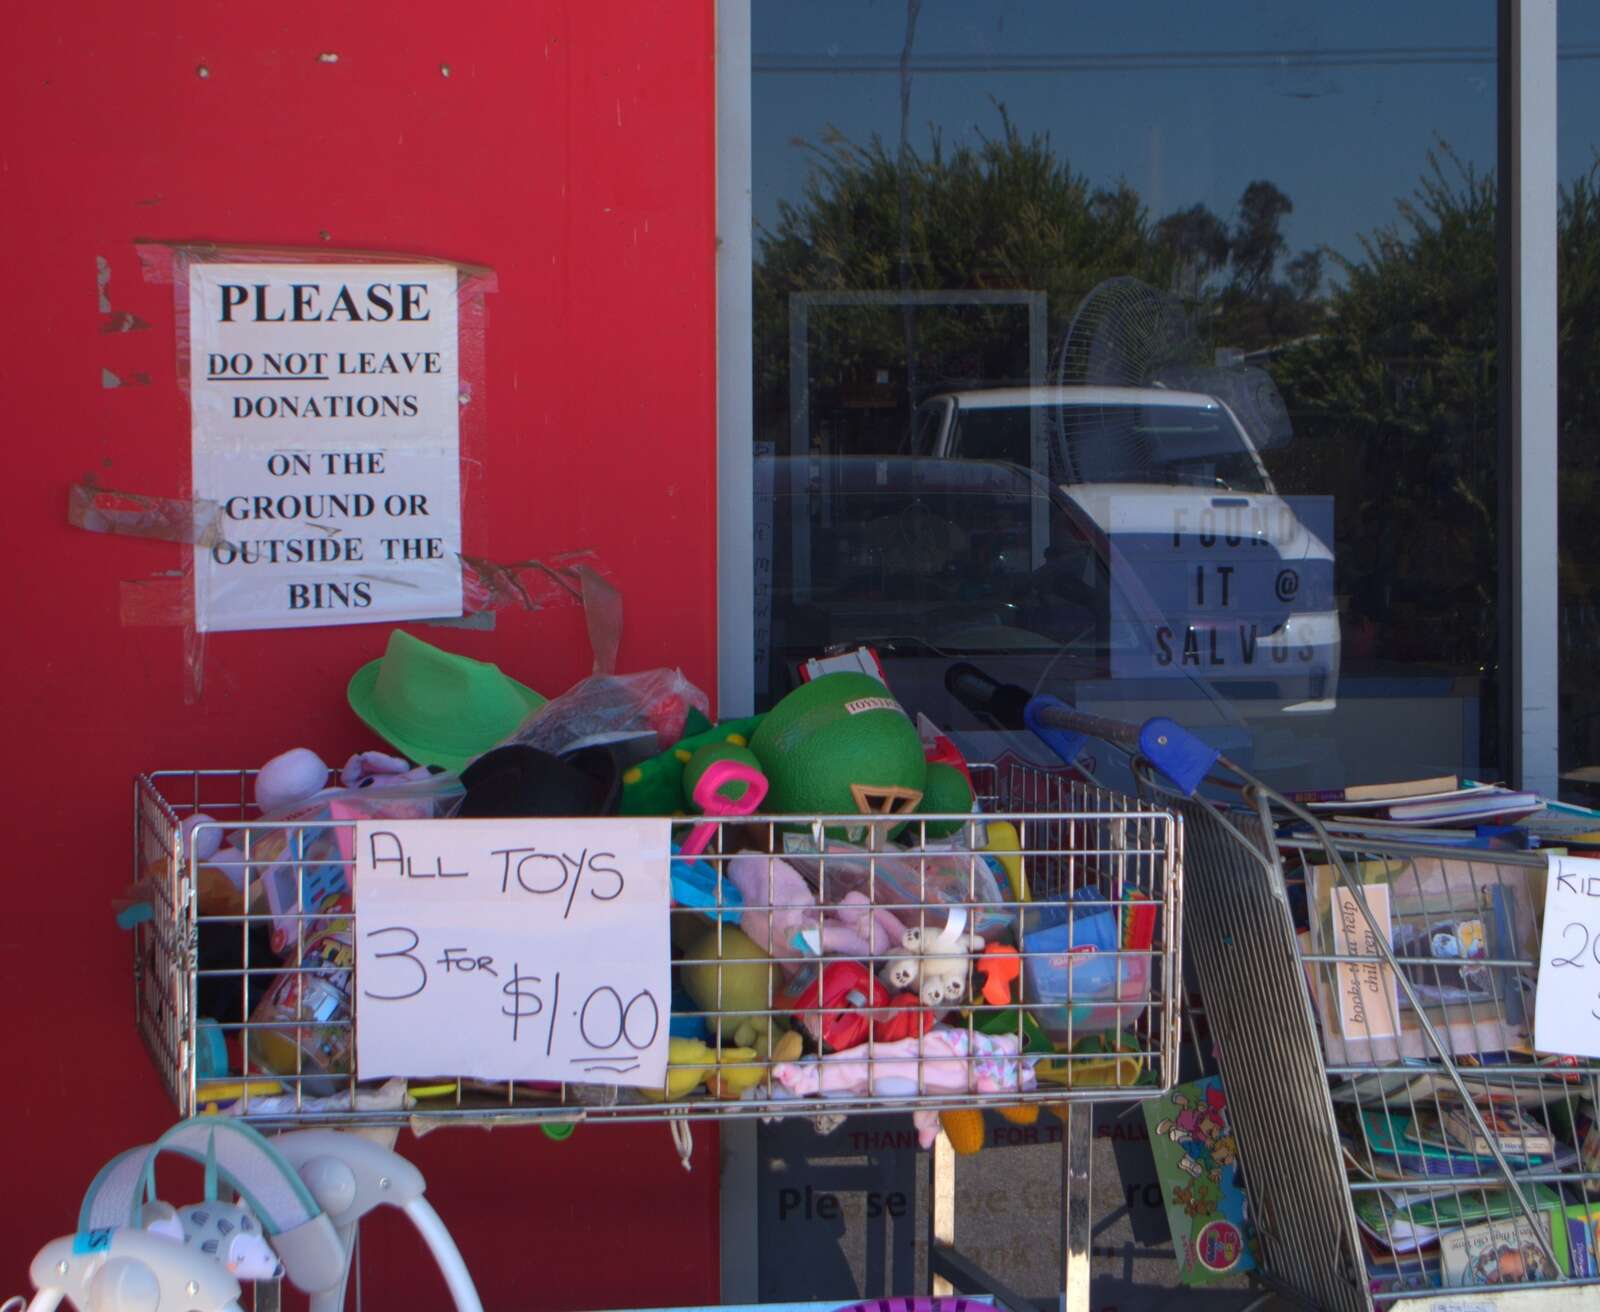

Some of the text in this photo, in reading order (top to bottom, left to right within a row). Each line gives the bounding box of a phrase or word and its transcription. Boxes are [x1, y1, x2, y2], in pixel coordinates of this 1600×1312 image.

[217, 283, 431, 323] PLEASE
[207, 351, 442, 377] DO NOT LEAVE
[232, 395, 419, 420] DONATIONS
[267, 452, 385, 477] ON THE
[225, 493, 430, 521] GROUND OR
[1173, 507, 1299, 548] FOUND
[211, 537, 445, 566] OUTSIDE THE
[288, 581, 373, 611] BINS
[1196, 565, 1299, 606] IT @
[1156, 624, 1314, 666] SALVOS
[369, 831, 624, 919] ALL TOYS
[1363, 929, 1379, 993] chilren
[364, 927, 427, 1000] 3
[436, 947, 498, 977] FOR
[502, 962, 659, 1056] $1.00
